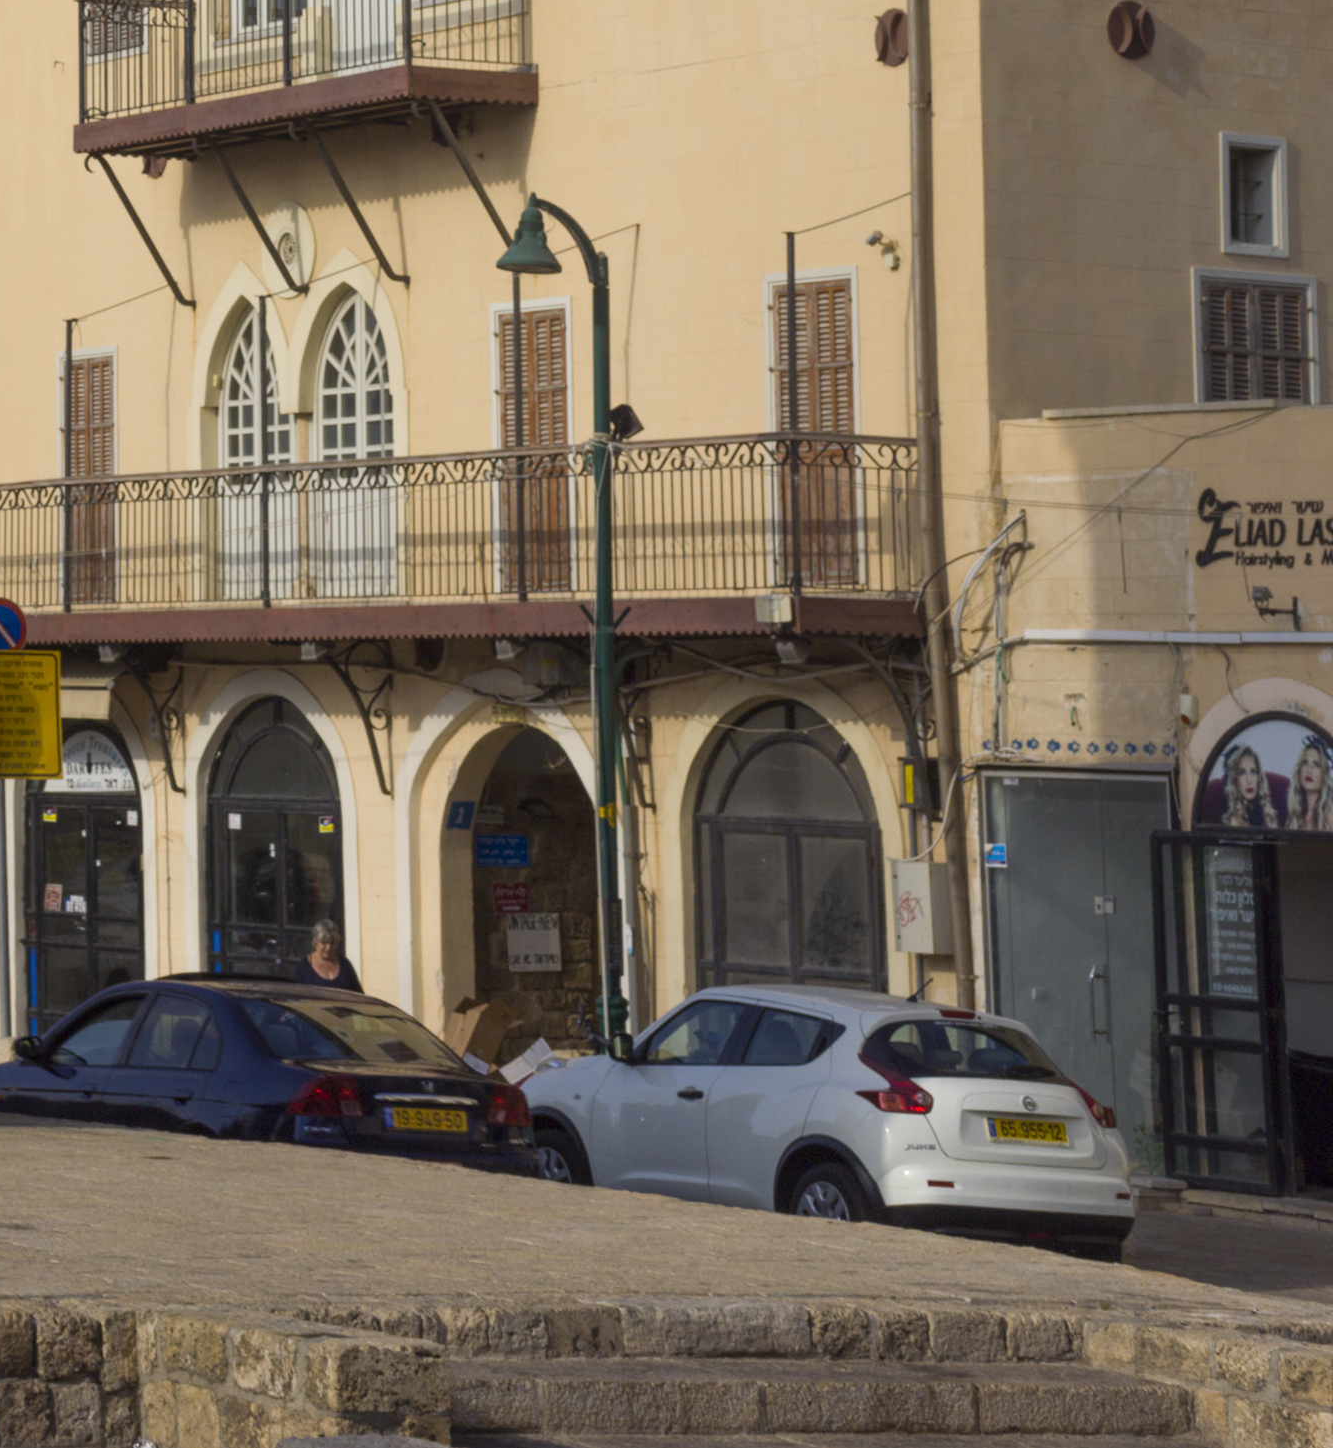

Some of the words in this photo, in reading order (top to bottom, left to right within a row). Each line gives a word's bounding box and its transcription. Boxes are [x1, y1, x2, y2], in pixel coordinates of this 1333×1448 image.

[1235, 551, 1295, 569] Hairstyling
[1304, 553, 1312, 566] &
[66, 762, 85, 775] DAR
[94, 762, 112, 775] FES
[455, 807, 464, 824] 1
[905, 1142, 937, 1151] JUKE
